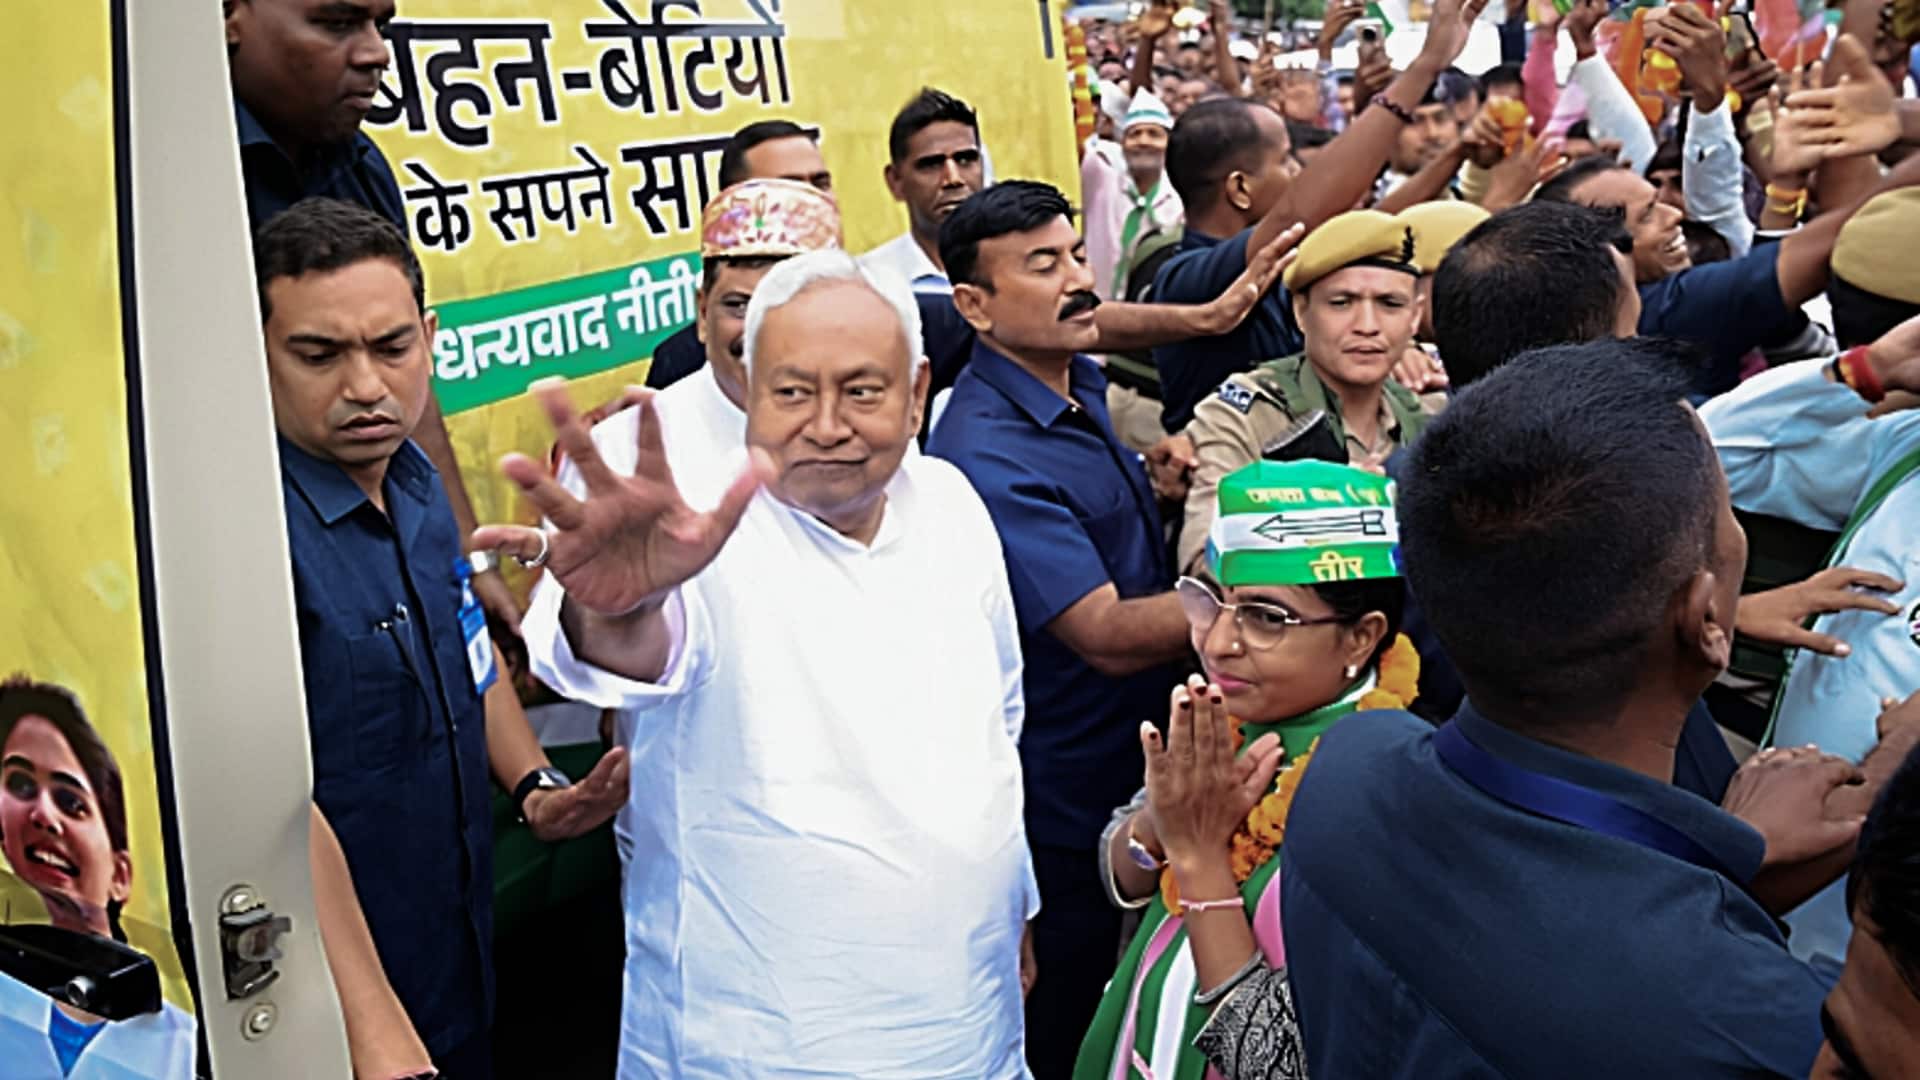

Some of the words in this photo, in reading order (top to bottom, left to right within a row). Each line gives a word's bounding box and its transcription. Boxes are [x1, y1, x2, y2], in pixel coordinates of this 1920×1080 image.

[405, 163, 471, 250] के
[482, 146, 613, 241] सपने
[433, 295, 610, 380] धन्यवाद
[611, 259, 704, 334] नीती
[1309, 551, 1365, 583] तीर
